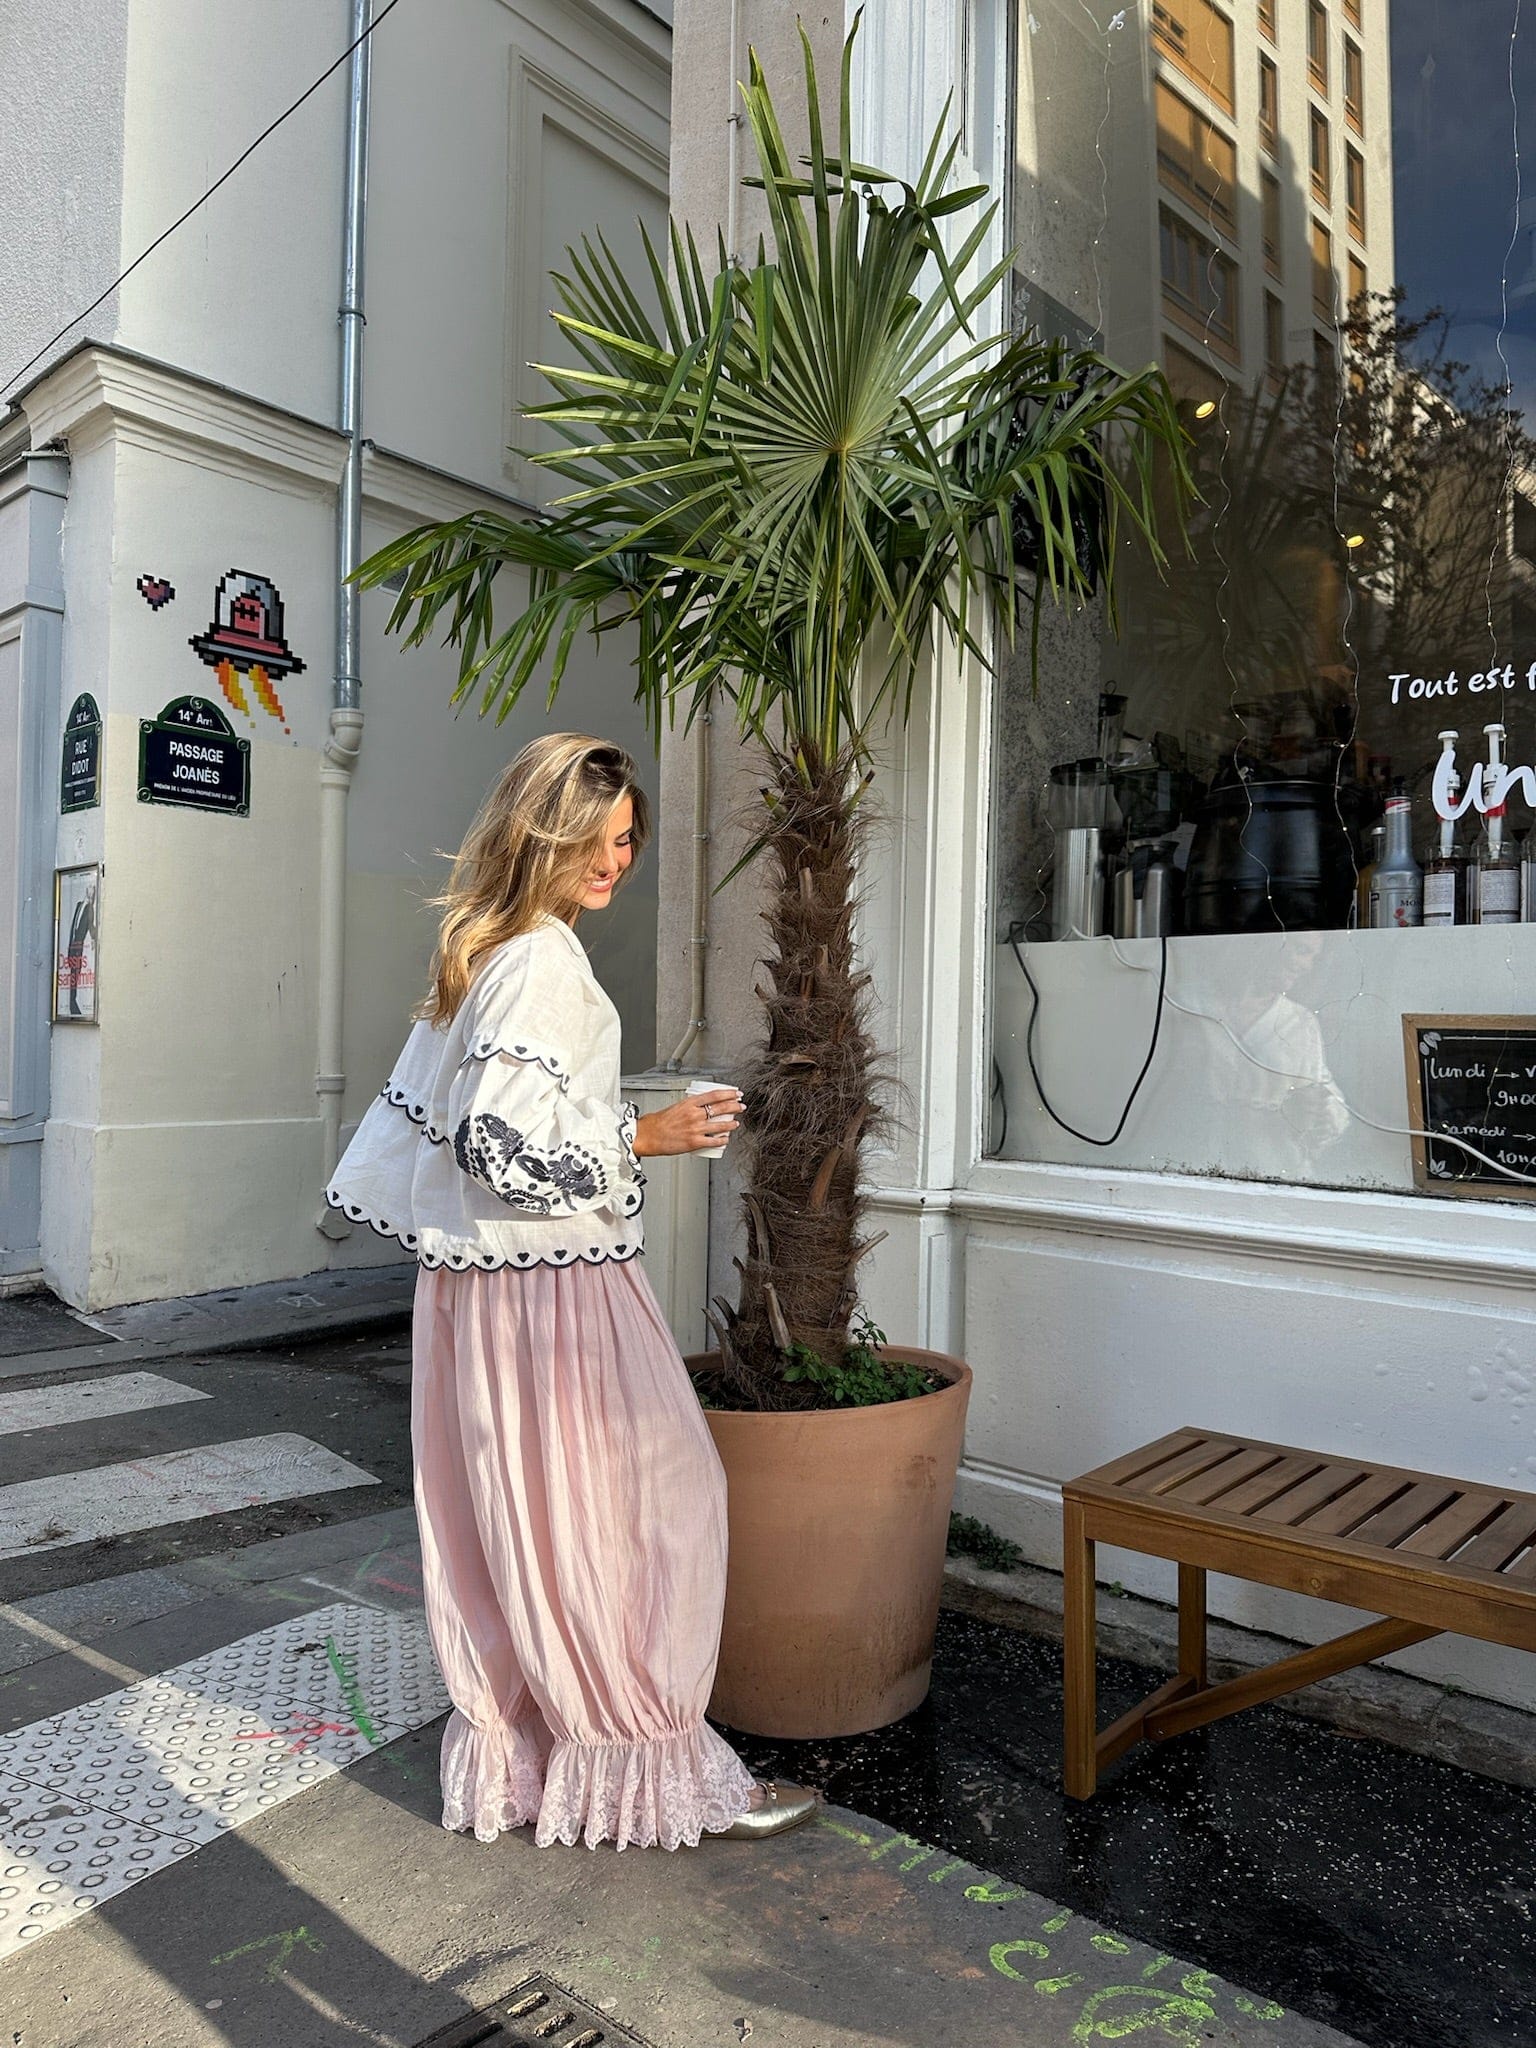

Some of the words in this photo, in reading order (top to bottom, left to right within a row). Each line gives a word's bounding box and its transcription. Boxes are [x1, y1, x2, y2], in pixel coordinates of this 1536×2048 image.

[1388, 670, 1459, 704] Tout
[1468, 663, 1516, 693] est
[75, 739, 88, 755] RUE
[169, 740, 224, 764] PASSAGE
[71, 758, 90, 776] DIDOT
[1431, 749, 1536, 821] Un
[1430, 1057, 1486, 1080] lundi
